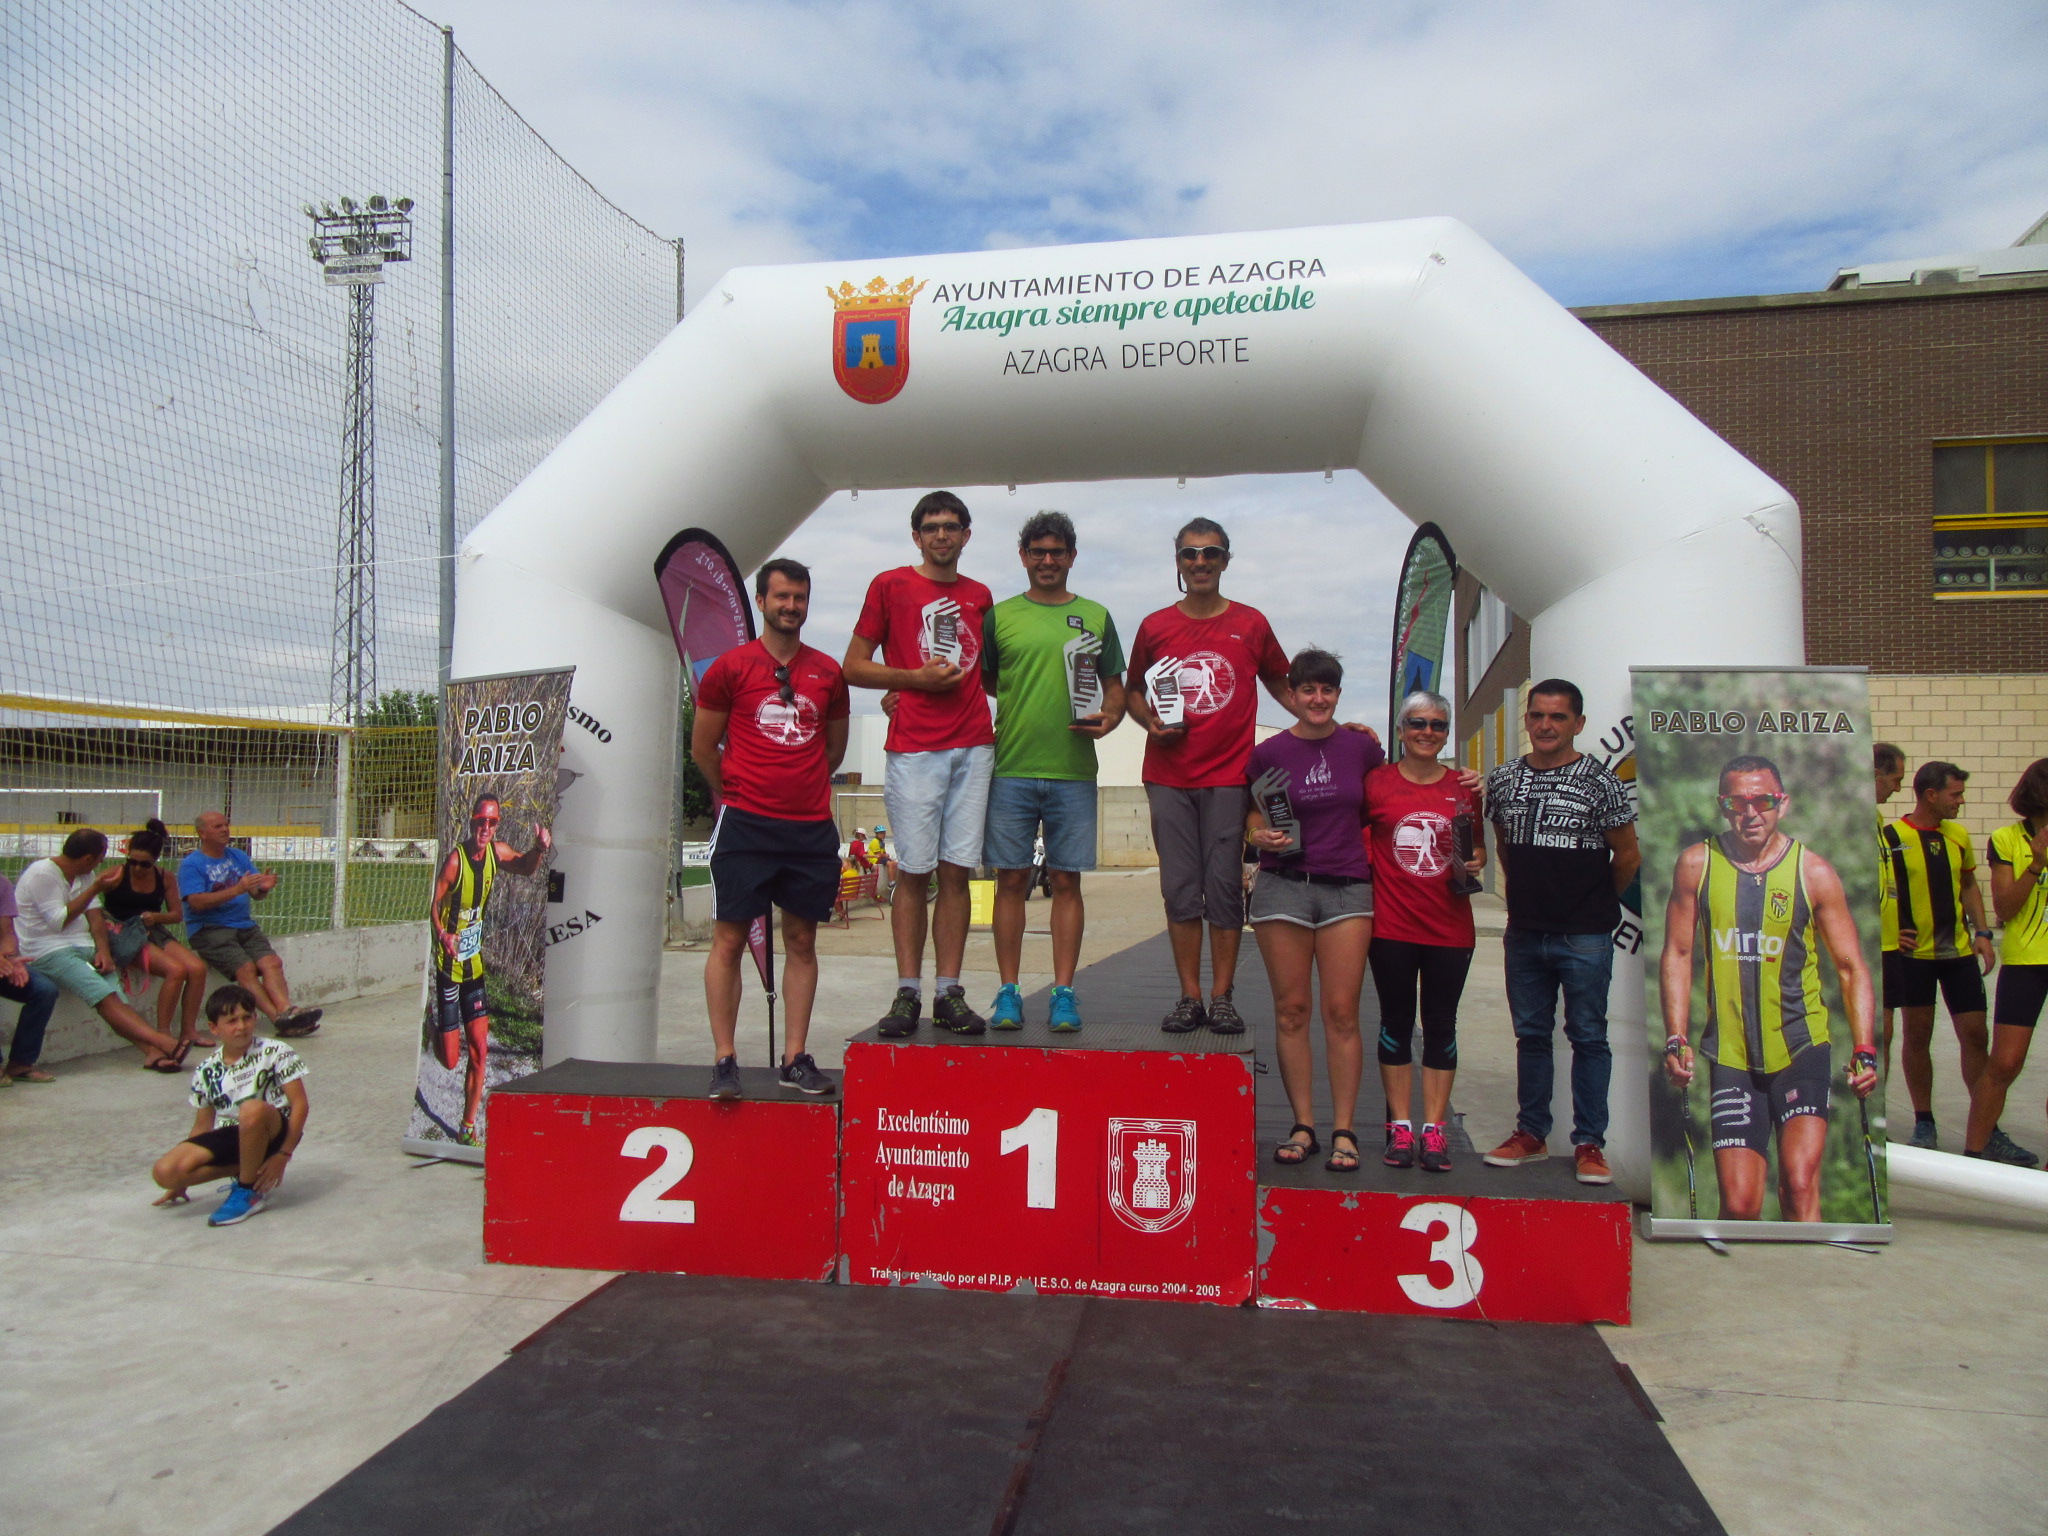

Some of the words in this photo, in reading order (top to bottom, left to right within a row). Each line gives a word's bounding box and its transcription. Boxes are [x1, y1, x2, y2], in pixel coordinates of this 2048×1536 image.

[932, 269, 1155, 303] AYUNTAMIENTO
[1163, 266, 1201, 287] DE
[1207, 258, 1327, 284] AZAGRA
[940, 305, 1052, 337] Azagra
[1056, 295, 1169, 330] siempre
[1173, 284, 1317, 324] apetecible
[1003, 345, 1107, 375] AZAGRA
[1122, 337, 1249, 369] DEPORTE
[464, 702, 543, 736] PABLO
[1650, 711, 1746, 734] PABLO
[1757, 711, 1855, 734] ARIZA
[458, 743, 536, 776] ARIZA
[1516, 767, 1534, 802] MARY
[1534, 775, 1566, 783] STRAIGHT
[1545, 798, 1592, 813] AMBITIONZ
[1541, 815, 1591, 829] JUICY
[1533, 833, 1578, 849] INSIDE
[546, 908, 602, 947] ESA
[1713, 928, 1783, 955] Virto
[877, 1107, 969, 1135] Excelentísimo
[875, 1141, 969, 1170] Ayuntamiento
[1000, 1107, 1058, 1209] 1
[620, 1126, 695, 1223] 2
[888, 1174, 903, 1197] de
[907, 1175, 955, 1206] Azagra
[1397, 1202, 1484, 1308] 3
[958, 1275, 976, 1286] por
[977, 1273, 987, 1285] el
[990, 1273, 1013, 1286] P.I.P.
[1034, 1276, 1072, 1289] I.E.S.O.
[1075, 1279, 1087, 1290] de
[1090, 1279, 1126, 1293] Azagra
[1129, 1284, 1159, 1293] curso
[1162, 1283, 1186, 1294] 2004
[1196, 1285, 1221, 1297] 2005
